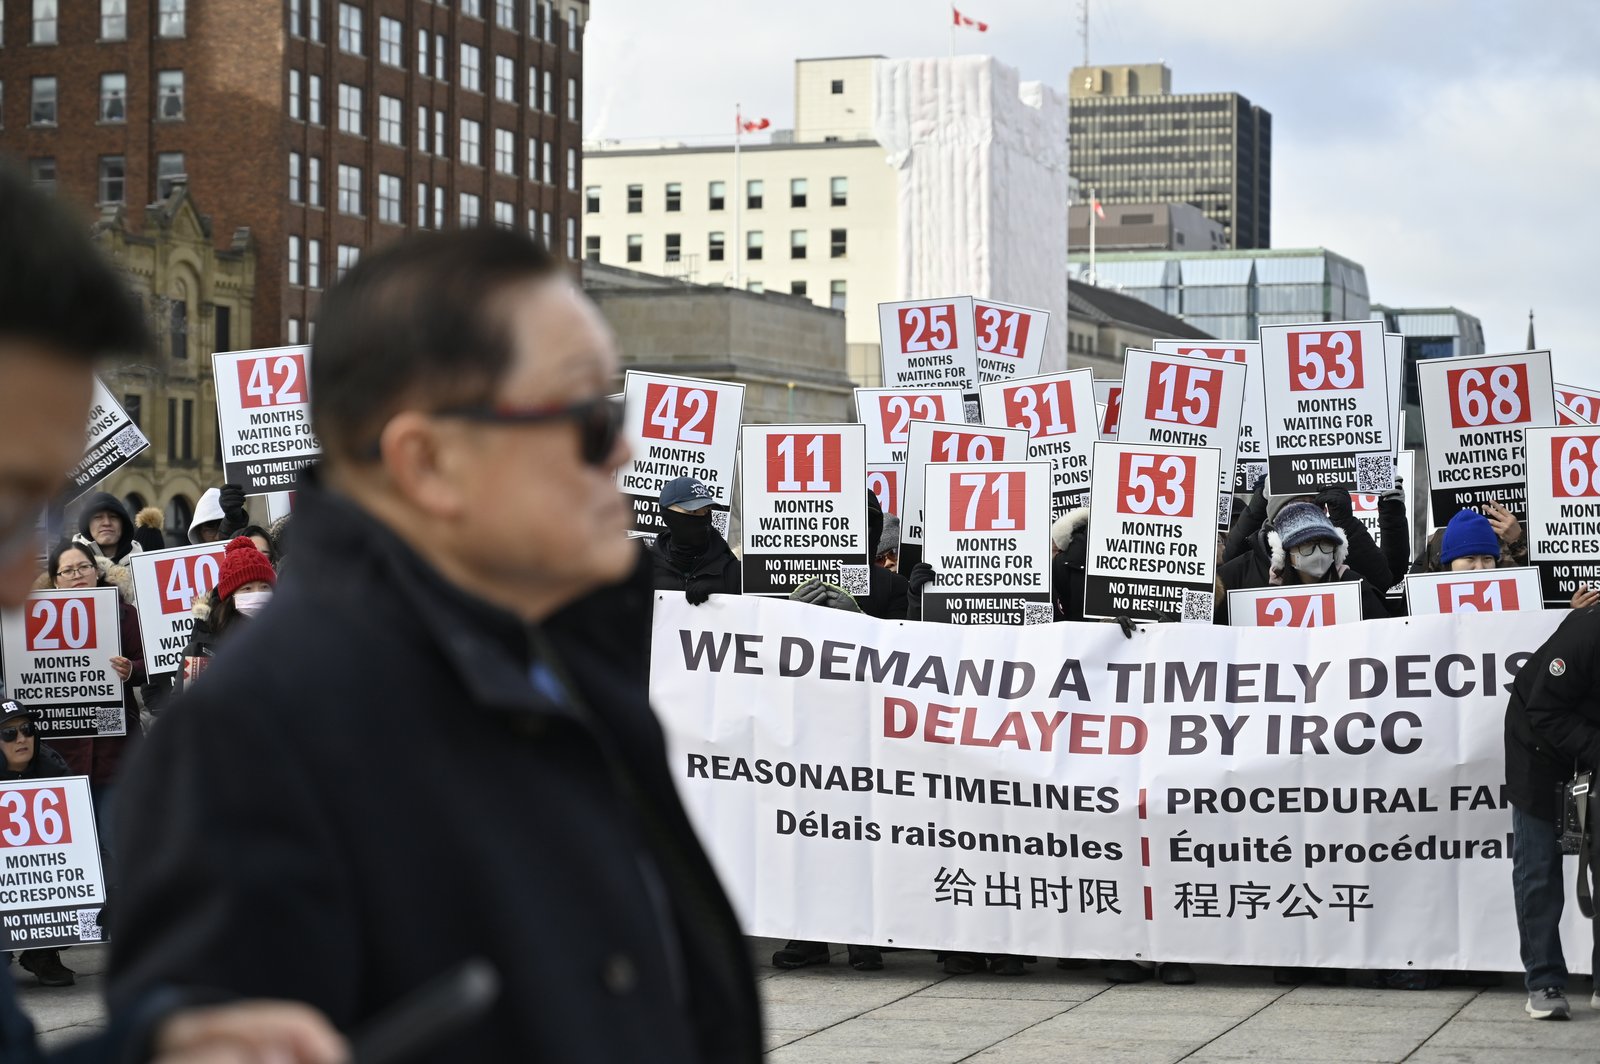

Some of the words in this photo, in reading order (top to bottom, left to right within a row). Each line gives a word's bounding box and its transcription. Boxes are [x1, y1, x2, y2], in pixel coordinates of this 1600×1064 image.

[904, 306, 951, 352] 25
[978, 308, 1020, 356] 31
[908, 354, 953, 368] MONTHS
[1298, 332, 1355, 390] 53
[246, 356, 300, 406] 42
[897, 368, 942, 382] WAITING
[945, 366, 966, 378] FOR
[1154, 364, 1212, 424] 15
[1458, 366, 1522, 426] 68
[1013, 383, 1068, 438] 31
[1298, 398, 1356, 413] MONTHS
[250, 410, 304, 425] MONTHS
[650, 386, 708, 442] 42
[1284, 416, 1342, 430] WAITING
[1346, 414, 1373, 428] FOR
[238, 425, 292, 441] WAITING
[295, 424, 313, 436] FO
[1150, 428, 1208, 446] MONTHS
[1276, 434, 1306, 448] IRCC
[1309, 430, 1382, 447] RESPONSE
[1460, 430, 1523, 447] MONTHS
[232, 444, 260, 456] IRCC
[649, 446, 705, 464] MONTHS
[1445, 448, 1508, 466] WAITING
[778, 435, 830, 491] 11
[1062, 454, 1088, 468] FOR
[1292, 460, 1308, 471] NO
[246, 464, 262, 475] NO
[634, 460, 688, 478] WAITING
[692, 468, 718, 482] FOR
[1438, 468, 1470, 482] IRCC
[1473, 463, 1525, 480] RESPO
[75, 472, 90, 486] NO
[252, 476, 268, 486] NO
[624, 475, 652, 490] IRCC
[1126, 454, 1186, 516] 53
[1298, 474, 1314, 485] NO
[960, 473, 1016, 530] 71
[1456, 492, 1472, 504] NO
[1474, 488, 1526, 502] TIMELIN
[634, 500, 650, 512] NO
[774, 500, 834, 514] MONTHS
[637, 514, 652, 525] NO
[760, 517, 818, 530] WAITING
[822, 517, 850, 530] FOR
[1122, 521, 1182, 538] MONTHS
[751, 534, 782, 548] IRCC
[784, 534, 858, 548] RESPONSE
[956, 538, 1017, 552] MONTHS
[1106, 538, 1165, 556] WAITING
[1170, 542, 1198, 558] FOR
[1538, 540, 1568, 554] IRCC
[766, 560, 782, 570] NO
[783, 559, 844, 570] TIMELINES
[940, 555, 1000, 568] WAITING
[1004, 555, 1032, 568] FOR
[1096, 556, 1127, 571] IRCC
[1129, 558, 1206, 576] RESPONSE
[770, 574, 786, 584] NO
[932, 573, 963, 586] IRCC
[966, 572, 1041, 586] RESPONSE
[1554, 566, 1570, 578] NO
[1108, 582, 1126, 594] NO
[1559, 580, 1576, 592] NO
[946, 598, 962, 610] NO
[964, 598, 1026, 610] TIMELINES
[1113, 598, 1130, 610] NO
[32, 599, 88, 650] 20
[951, 612, 968, 624] NO
[970, 612, 1021, 624] RESULTS
[34, 656, 90, 669] MONTHS
[678, 629, 764, 675] WE
[778, 635, 1036, 700] DEMAND
[1048, 658, 1092, 702] A
[1106, 660, 1331, 704] TIMELY
[20, 671, 76, 684] WAITING
[80, 670, 106, 682] FOR
[14, 688, 42, 700] IRCC
[46, 684, 114, 699] RESPONSE
[52, 718, 98, 730] RESULTS
[883, 697, 1148, 755] DELAYED
[1168, 714, 1250, 756] BY
[1266, 710, 1424, 756] IRCC
[686, 753, 916, 797] REASONABLE
[922, 772, 1120, 814] TIMELINES
[1166, 786, 1438, 814] PROCEDURAL
[0, 788, 64, 846] 36
[776, 809, 882, 842] Délais
[890, 823, 1124, 861] raisonnables
[1169, 829, 1292, 869] Équité
[1304, 834, 1514, 868] procédural
[6, 852, 66, 869] MONTHS
[56, 868, 84, 882] FOR
[20, 884, 96, 902] RESPONSE
[934, 866, 1122, 916] 给出时限
[1174, 880, 1374, 922] 程序公平
[4, 915, 20, 928] NO
[22, 910, 78, 926] TIMELINE
[10, 929, 28, 941] NO
[30, 925, 80, 939] RESULTS
